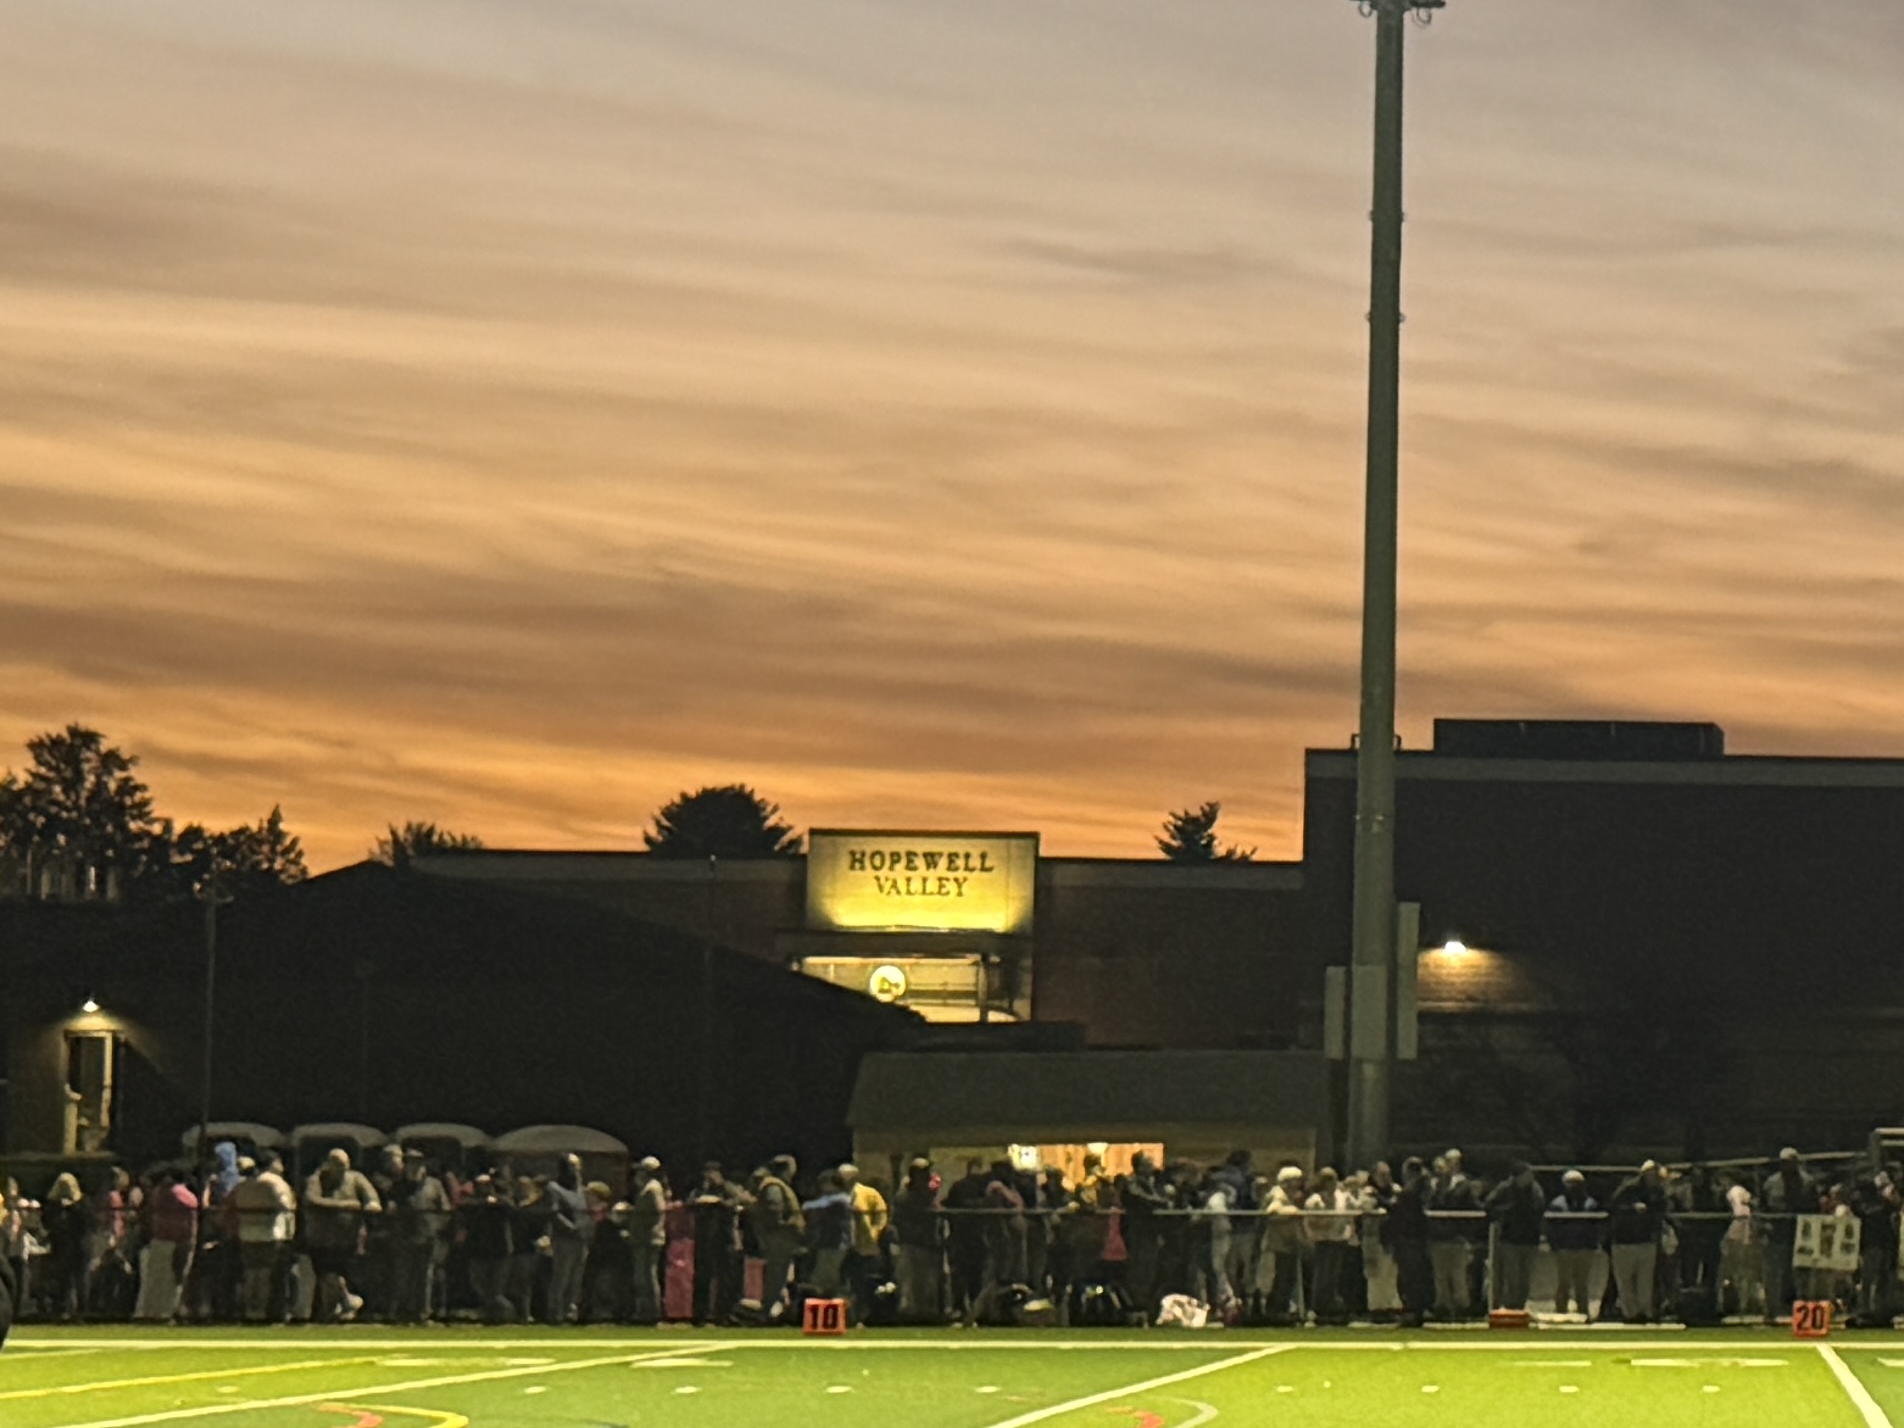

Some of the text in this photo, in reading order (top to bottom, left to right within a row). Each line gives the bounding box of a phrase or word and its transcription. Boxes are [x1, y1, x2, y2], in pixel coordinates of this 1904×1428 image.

[849, 849, 995, 872] HOPEWELL
[873, 875, 968, 897] VALLEY
[808, 1303, 839, 1330] 10
[1796, 1304, 1825, 1331] 20
